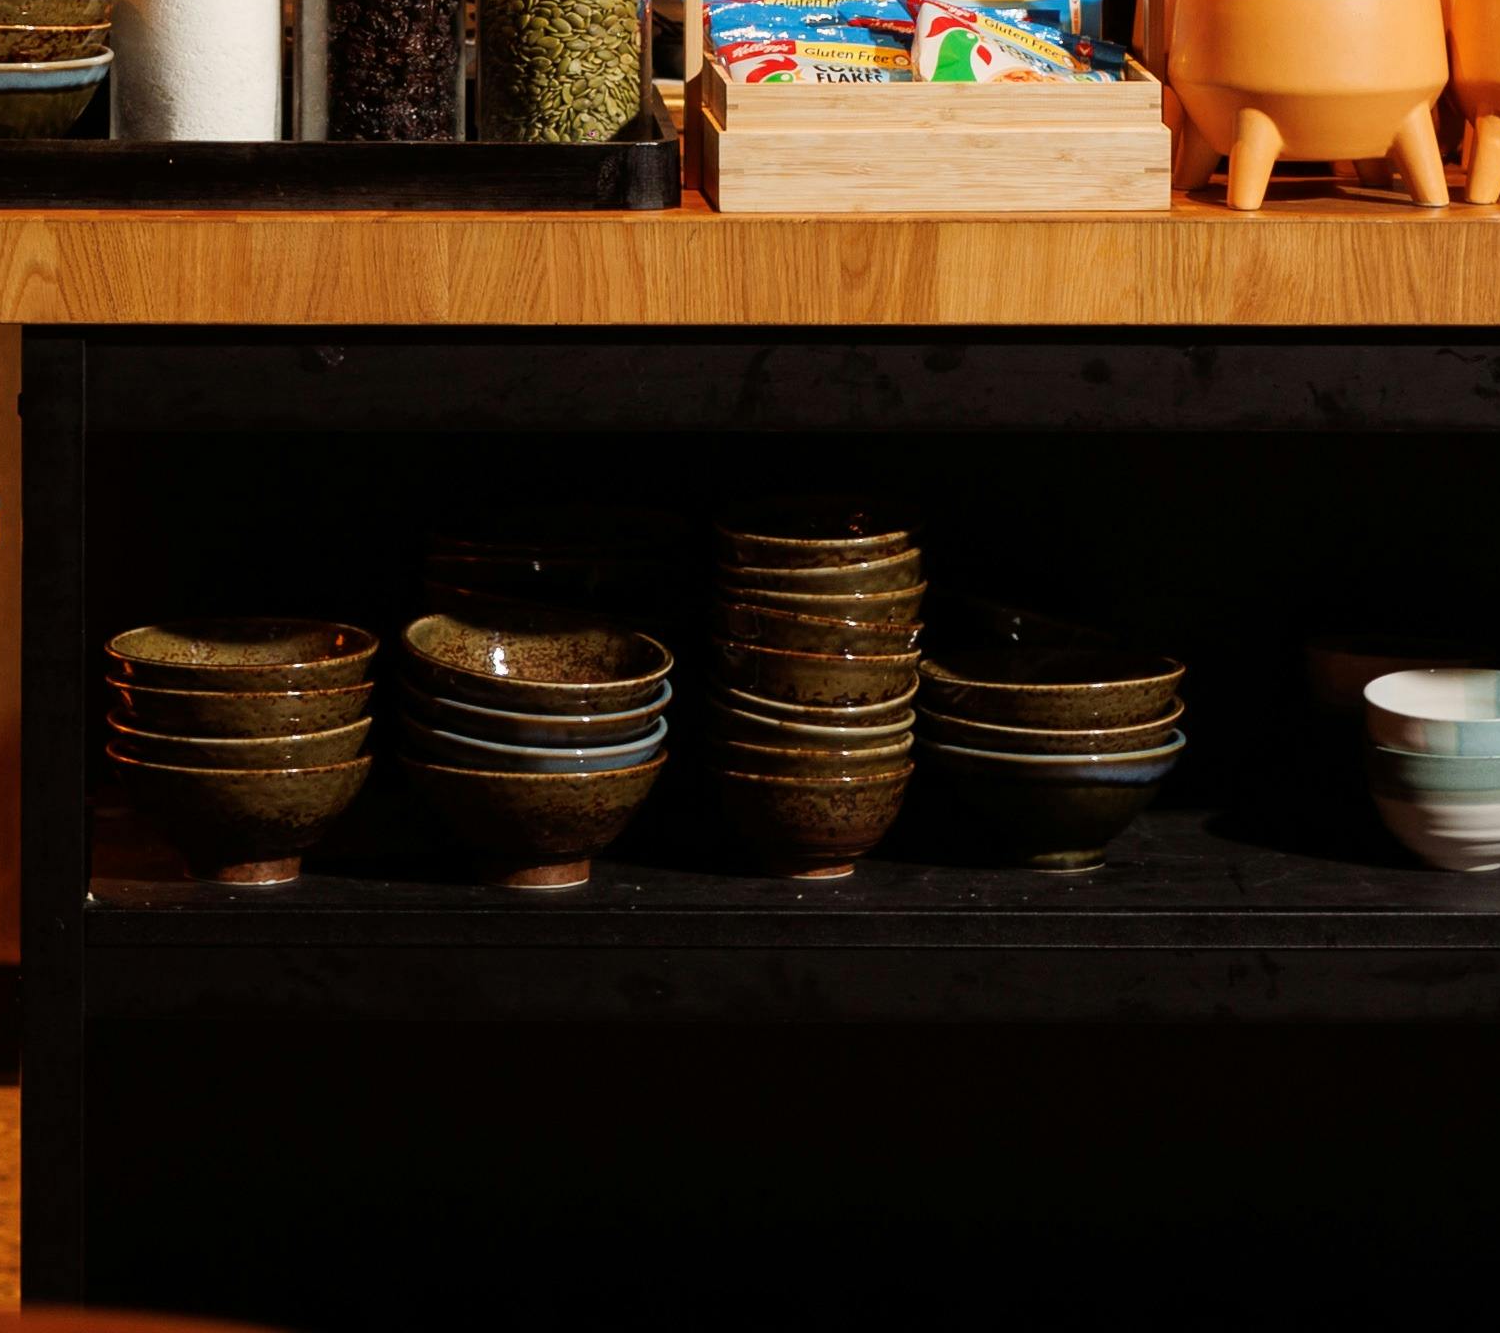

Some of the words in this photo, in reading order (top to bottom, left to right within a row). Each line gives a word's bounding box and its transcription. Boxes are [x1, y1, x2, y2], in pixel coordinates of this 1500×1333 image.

[732, 44, 792, 58] Kellogg's
[804, 47, 854, 61] Gluten
[858, 49, 889, 65] Free
[984, 18, 1029, 44] Gluten
[1031, 40, 1059, 60] Free
